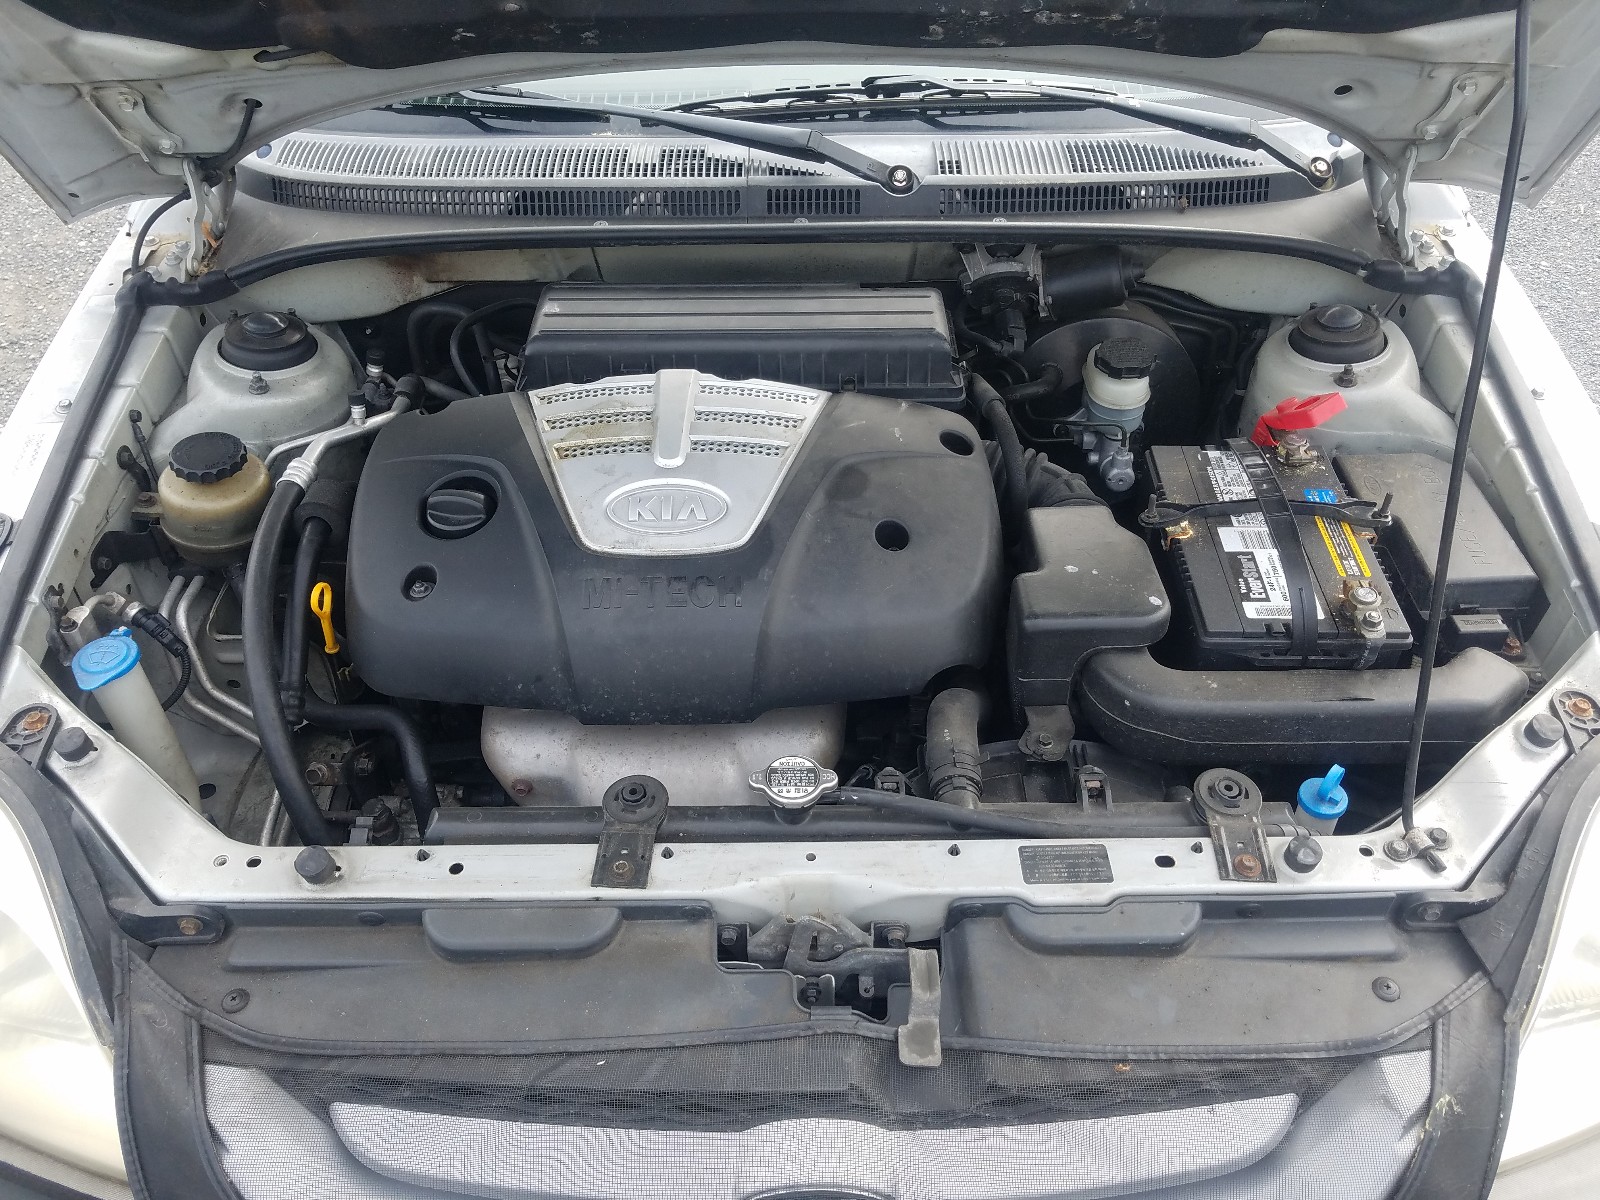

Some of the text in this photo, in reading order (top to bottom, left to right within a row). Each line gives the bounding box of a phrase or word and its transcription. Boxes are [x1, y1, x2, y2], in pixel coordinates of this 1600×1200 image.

[628, 495, 708, 522] KIA
[1237, 555, 1266, 599] EverStart
[1238, 578, 1248, 594] Value
[583, 576, 743, 610] MI-TECH
